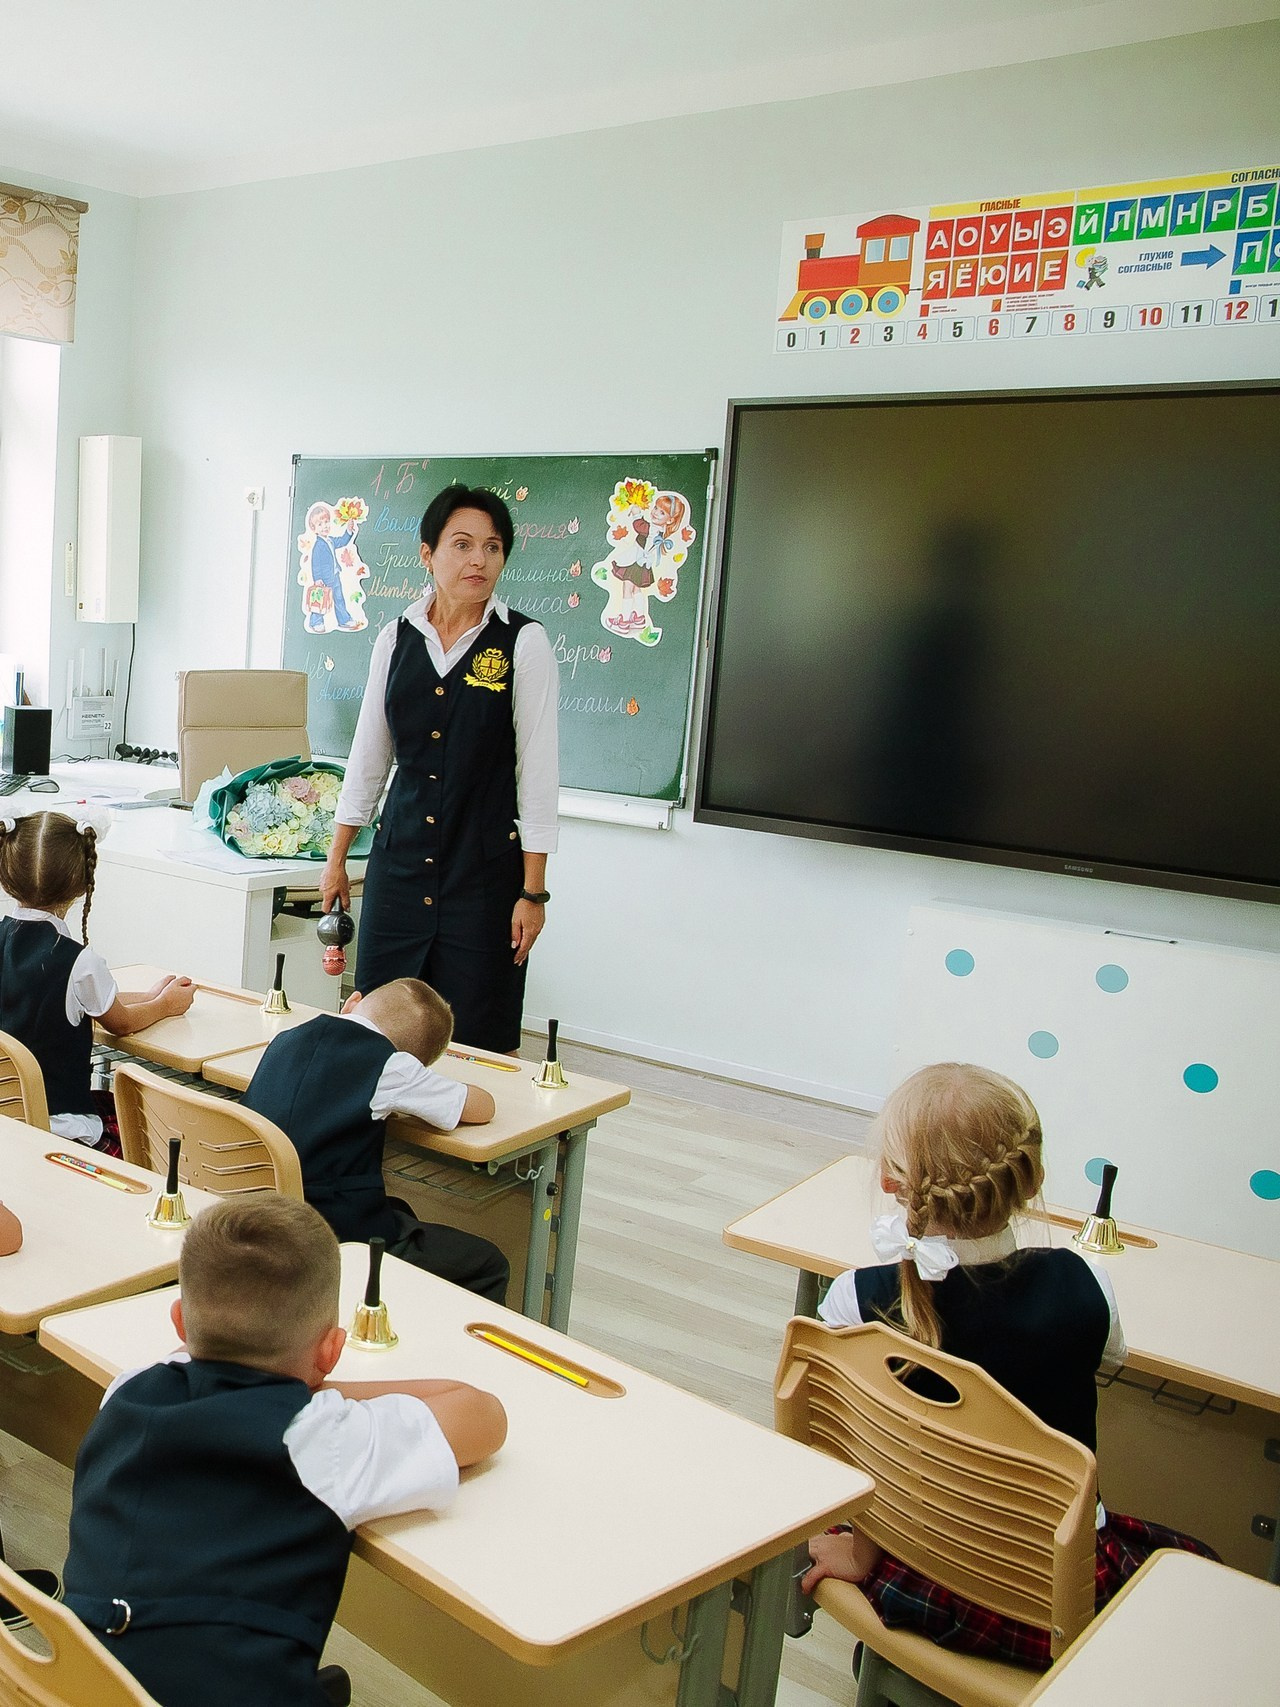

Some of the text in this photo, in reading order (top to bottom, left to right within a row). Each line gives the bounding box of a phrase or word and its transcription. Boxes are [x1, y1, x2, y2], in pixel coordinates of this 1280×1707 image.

[1231, 168, 1280, 184] СОГЛАСН
[979, 198, 1021, 213] ГЛАСНЫЕ
[929, 194, 1269, 250] А О У Ы Э Й Л М Н Р Б
[1138, 250, 1174, 262] глухие
[1240, 240, 1264, 264] П
[926, 259, 1062, 291] Я Ё Ю И Е
[1117, 261, 1173, 275] согласные
[787, 298, 1278, 348] 0 1 2 3 4 5 6 7 8 9 10 11 12 1
[508, 507, 571, 551] офия
[499, 567, 574, 583] нгелина
[499, 594, 570, 615] илиса
[552, 632, 601, 680] Вера
[316, 671, 365, 703] Алекса
[558, 694, 627, 714] ихаил
[104, 722, 111, 730] 22
